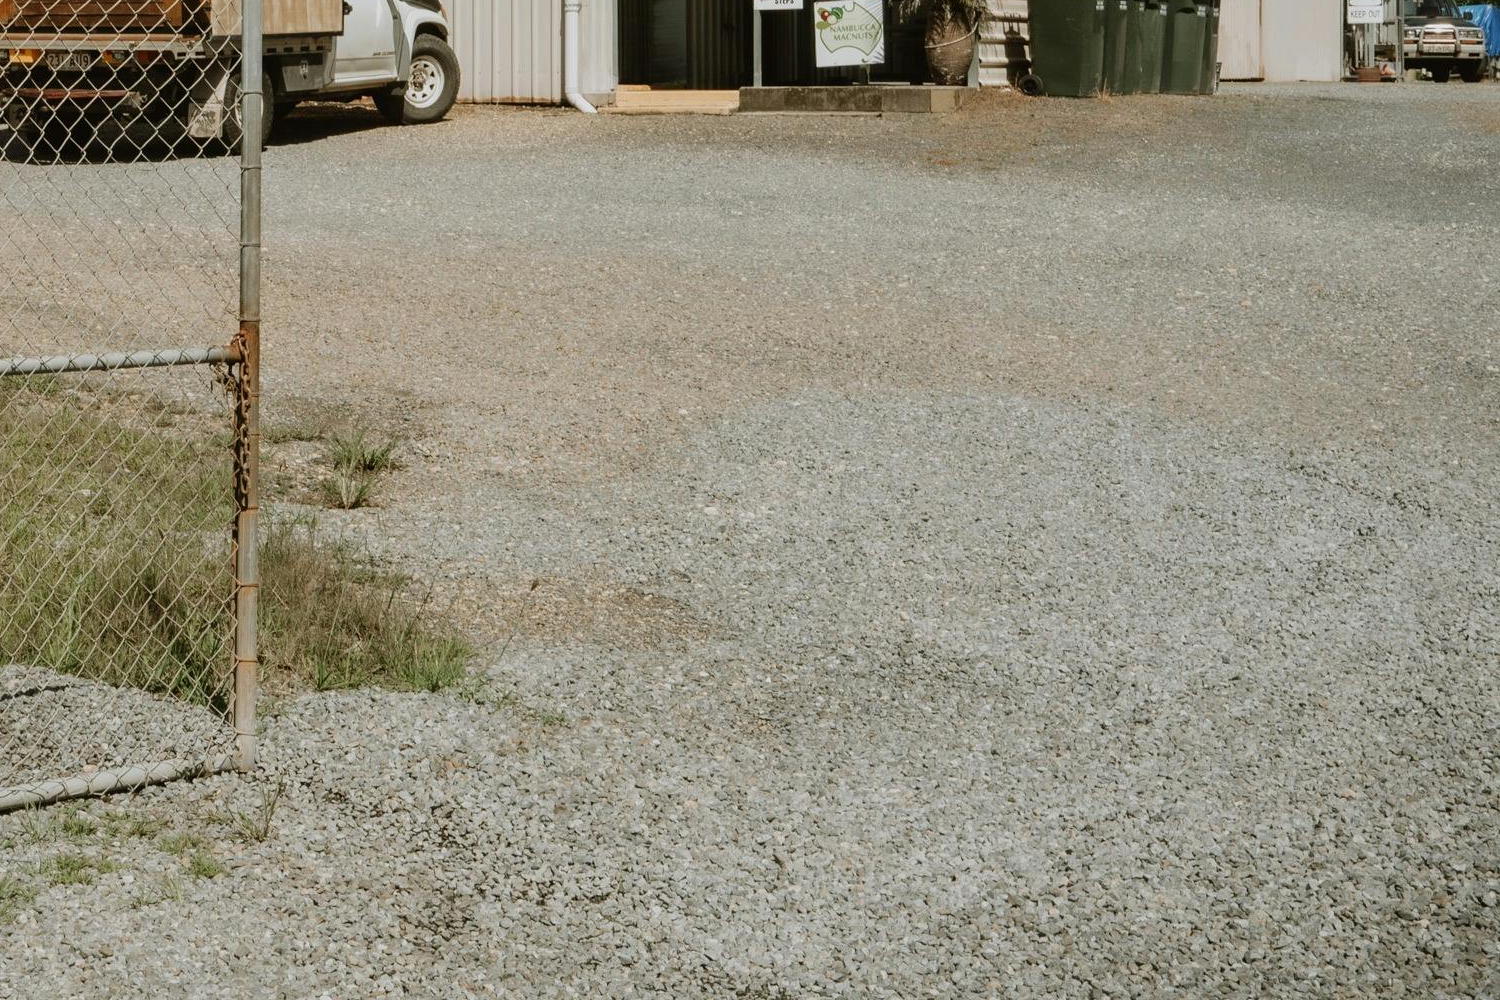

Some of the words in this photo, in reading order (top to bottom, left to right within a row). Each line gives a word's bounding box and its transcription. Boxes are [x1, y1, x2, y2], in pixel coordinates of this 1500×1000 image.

[1350, 10, 1366, 19] KEEP
[1368, 10, 1381, 18] OUT
[830, 23, 876, 33] NAMBUCCA
[833, 31, 874, 41] MACNUTS
